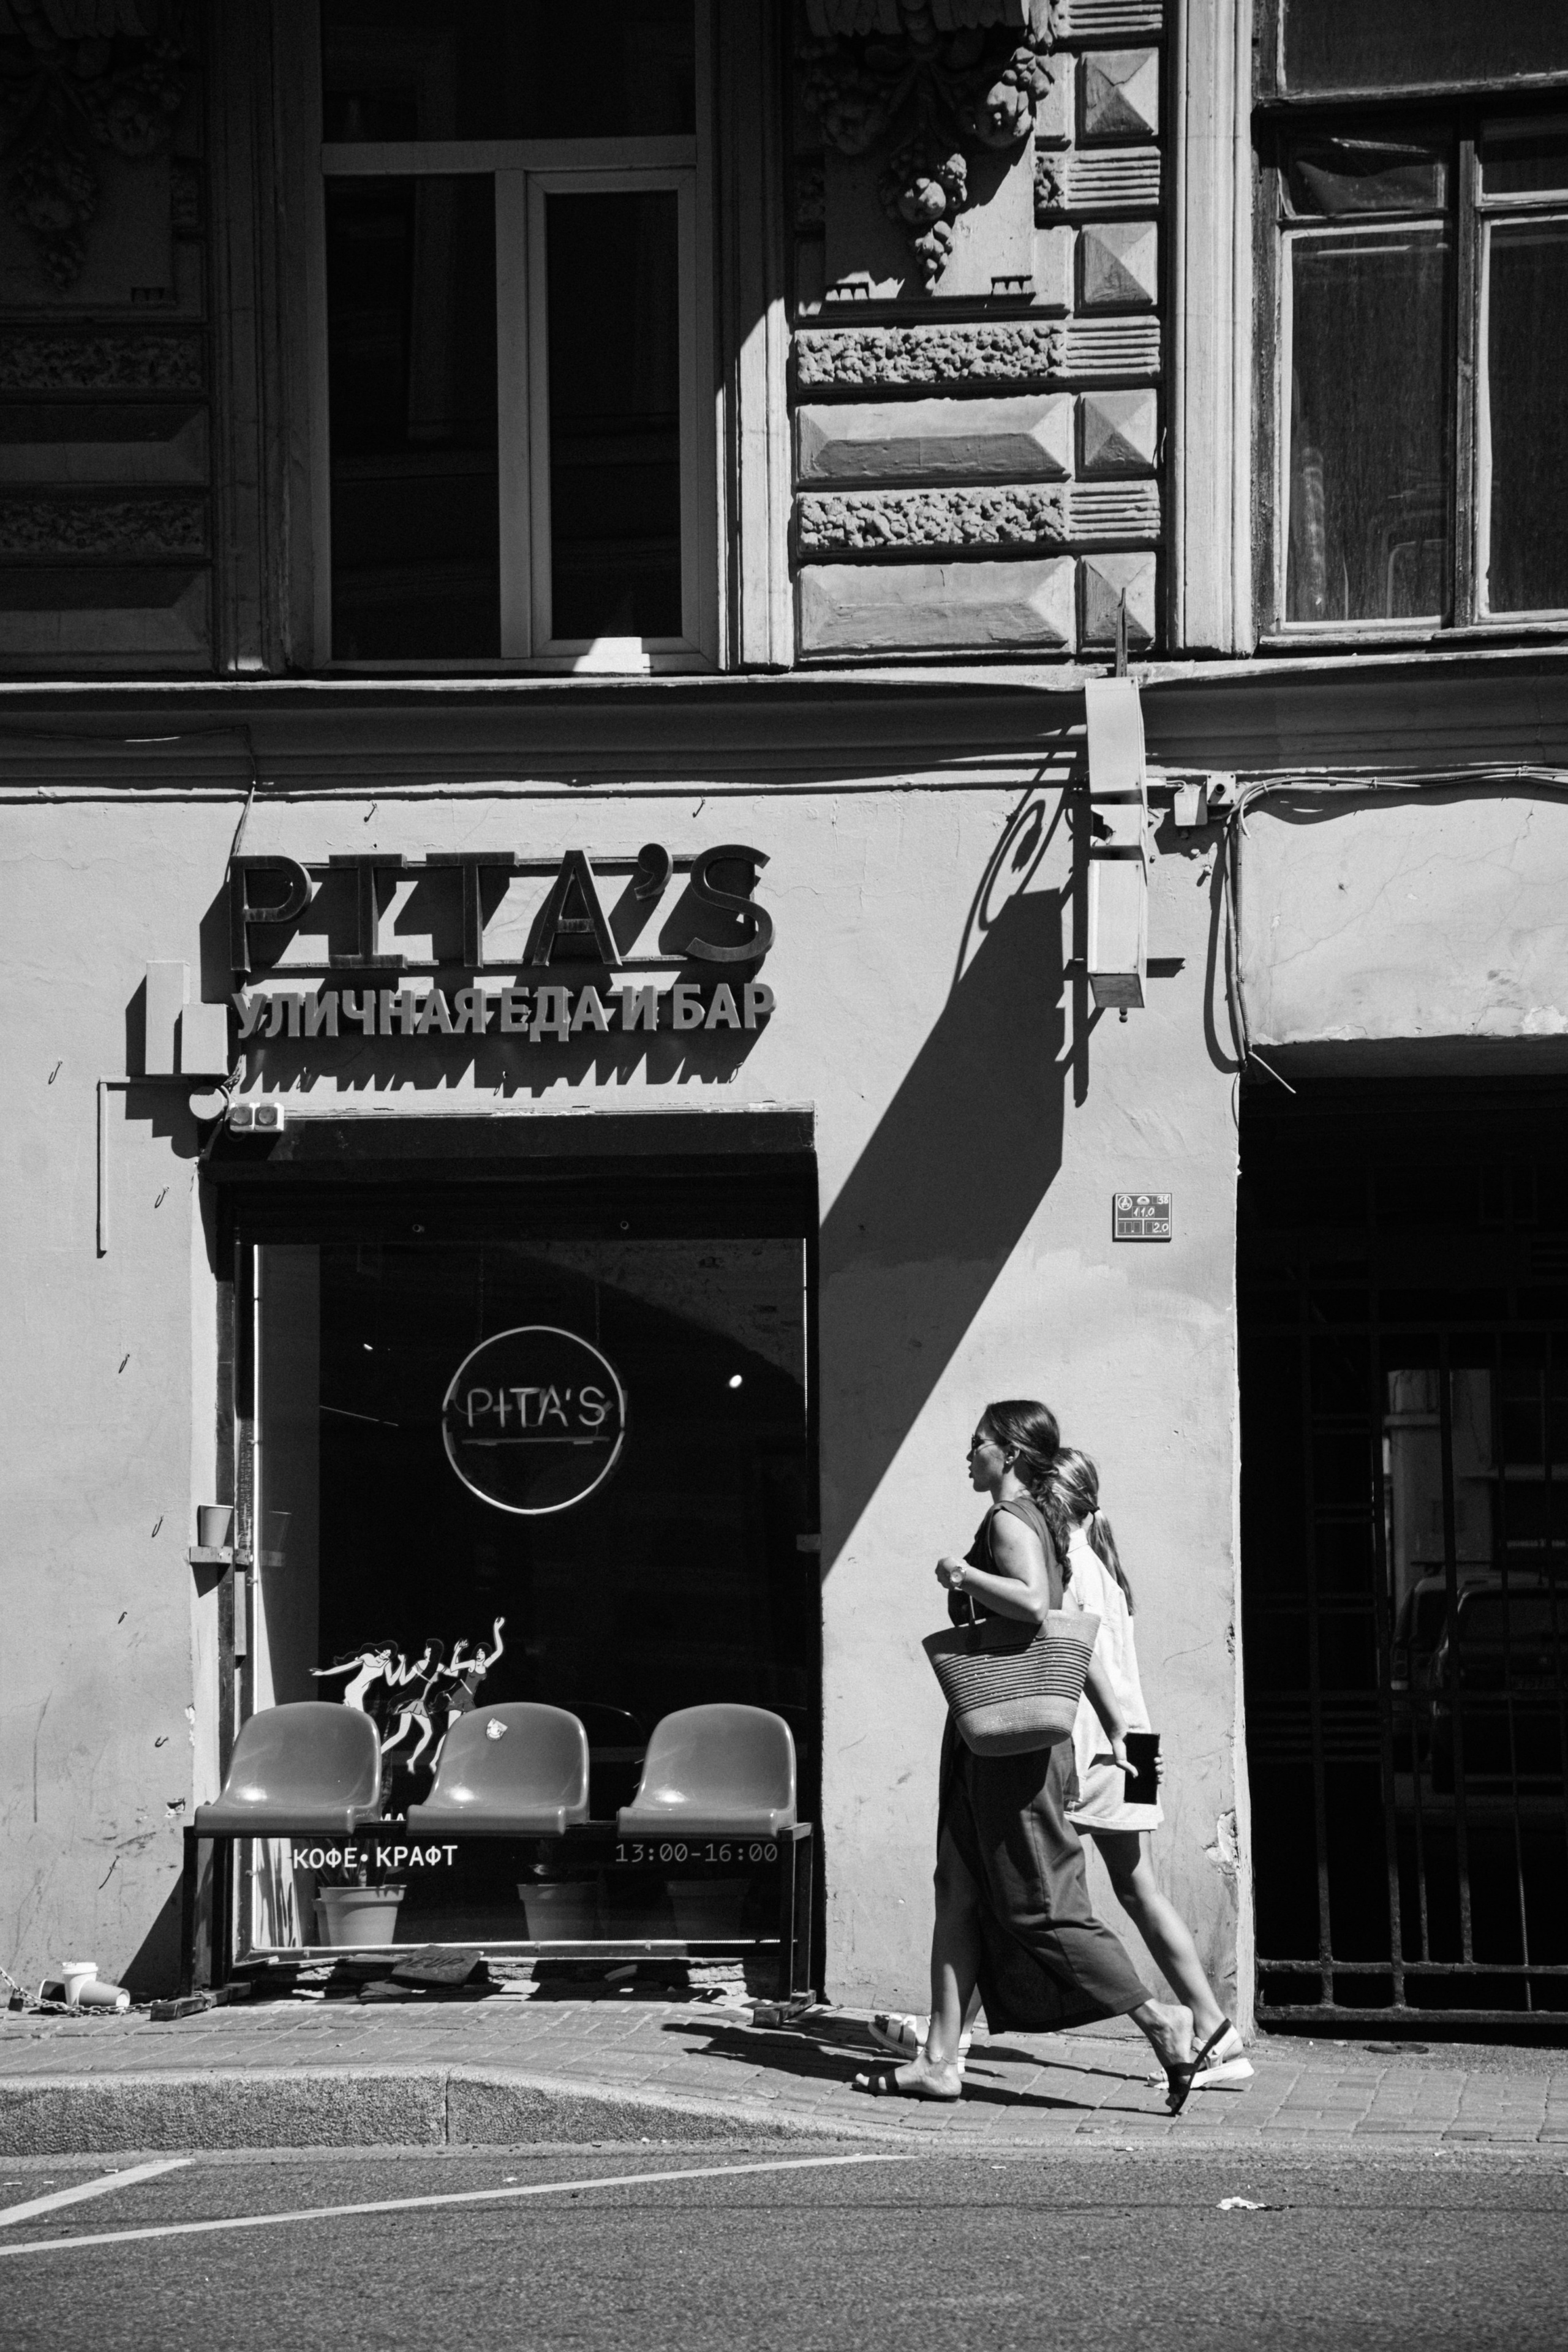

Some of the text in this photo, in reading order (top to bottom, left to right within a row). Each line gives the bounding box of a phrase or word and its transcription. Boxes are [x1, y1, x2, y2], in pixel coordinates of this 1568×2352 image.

[232, 982, 777, 1042] УЛИЧНАЯ ЕДА И БАР
[1134, 1207, 1155, 1216] 11.0
[1153, 1222, 1169, 1233] 2.0
[467, 1384, 606, 1428] PITA'S
[375, 1845, 458, 1867] КРАФТ
[615, 1842, 778, 1863] 13:00-16:00
